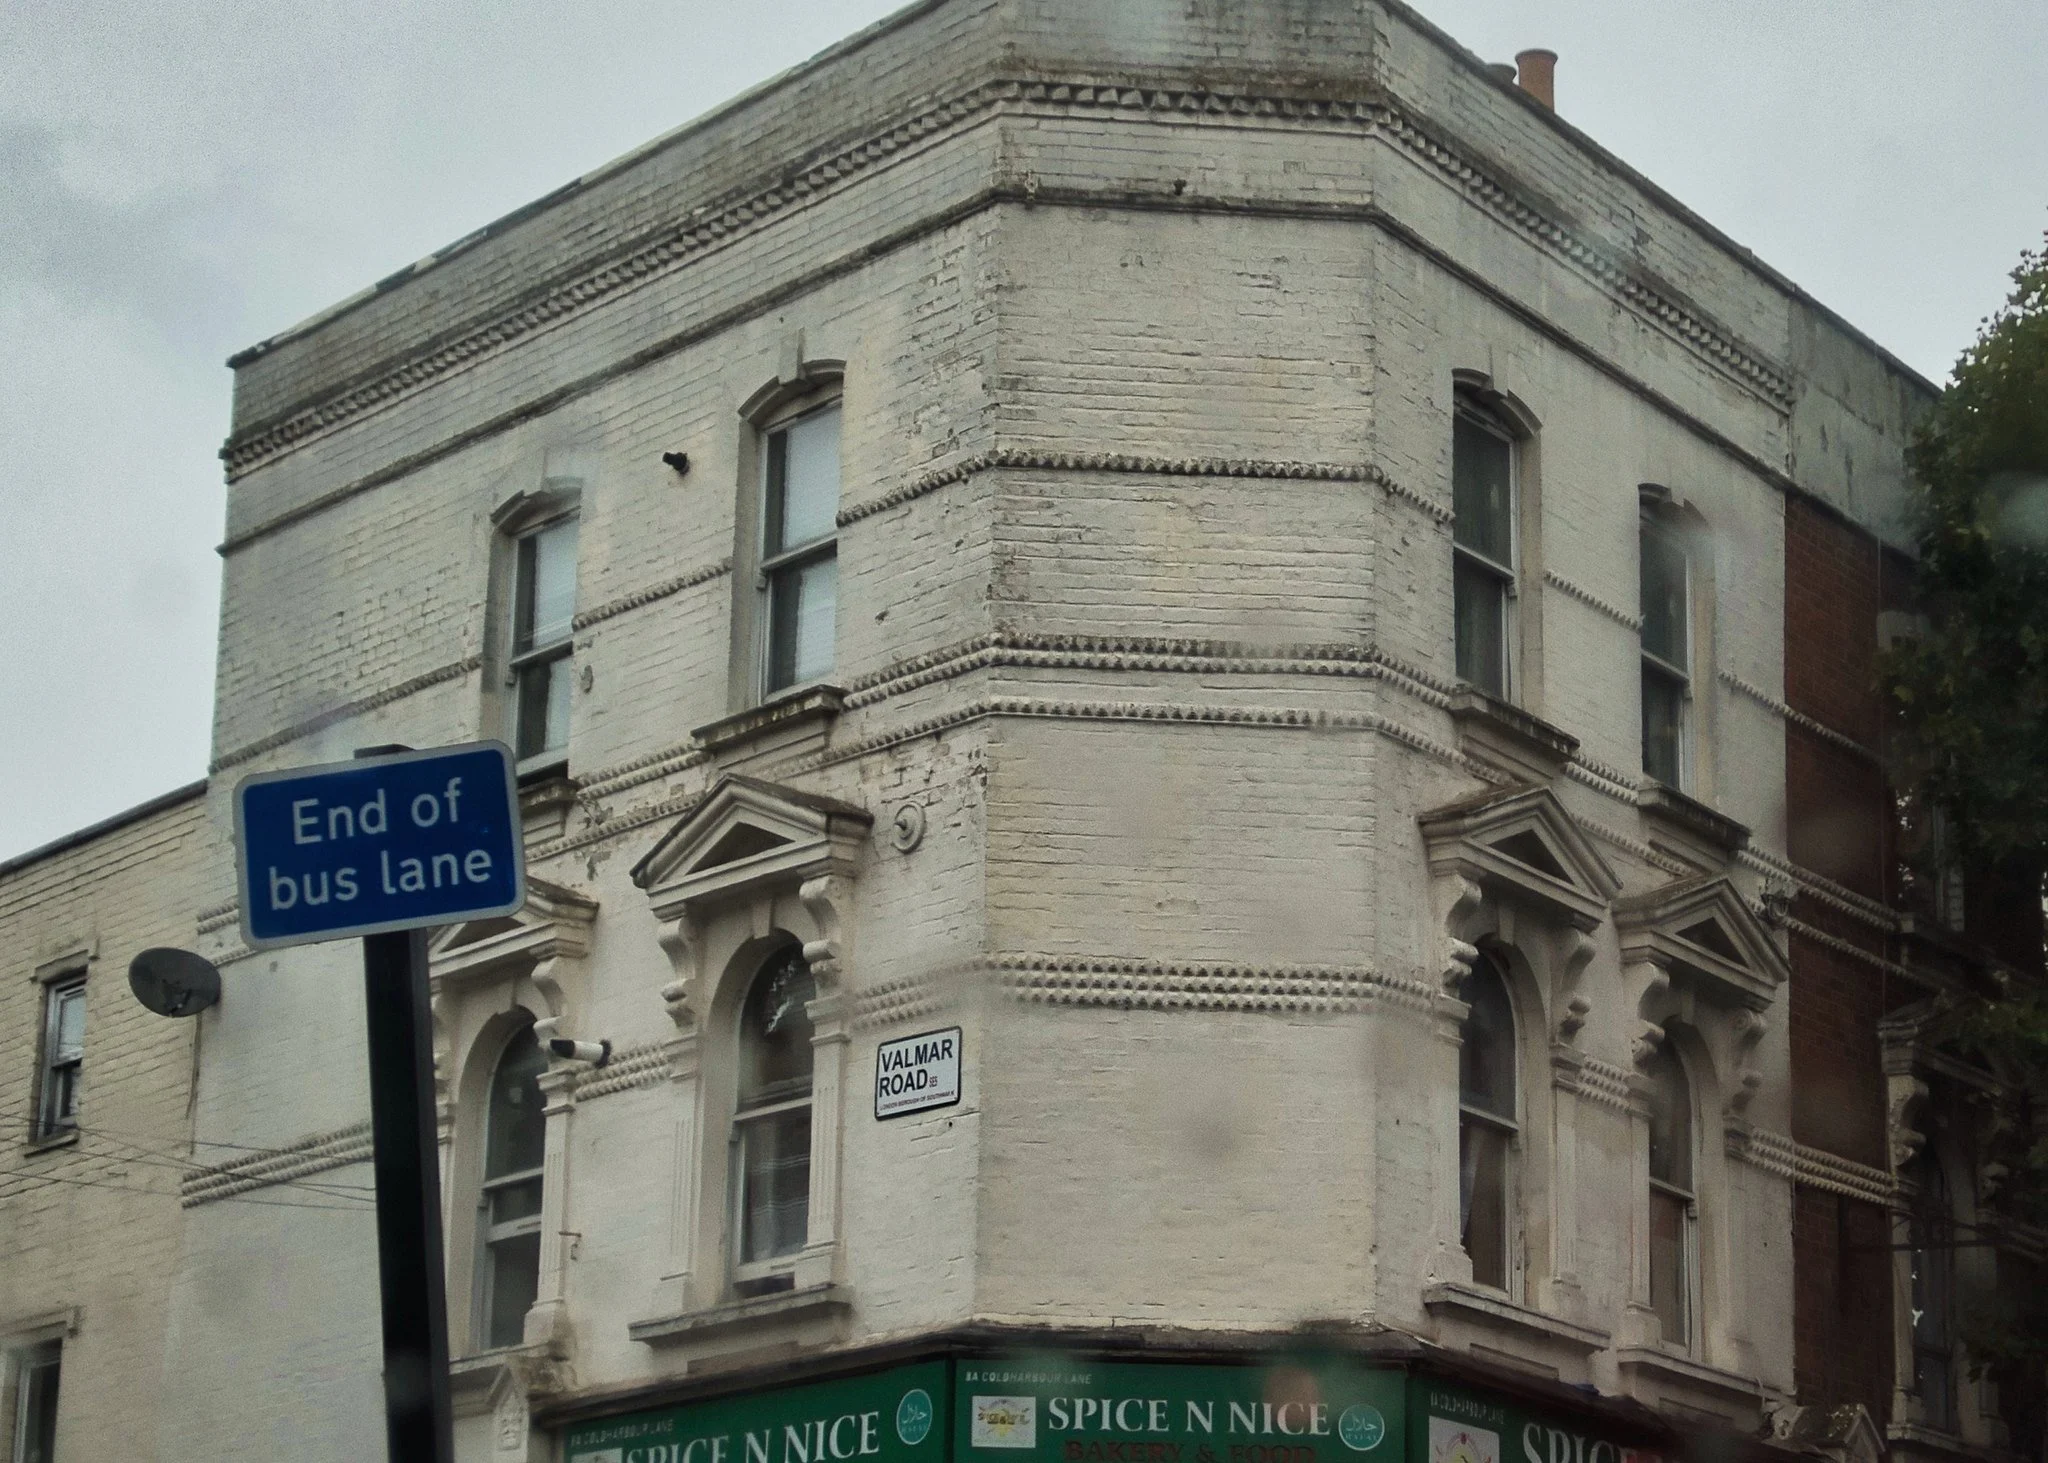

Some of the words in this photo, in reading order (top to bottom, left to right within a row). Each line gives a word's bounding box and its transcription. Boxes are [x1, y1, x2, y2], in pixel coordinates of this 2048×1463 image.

[292, 788, 388, 846] End
[410, 776, 463, 828] of
[268, 865, 360, 911] bus
[380, 848, 492, 896] lane
[881, 1038, 953, 1073] VALMAR
[879, 1068, 928, 1098] ROAD
[981, 1371, 1060, 1384] COLDHARBOUR
[1063, 1373, 1092, 1385] LANE
[1048, 1397, 1170, 1432] SPICE
[1186, 1400, 1214, 1433] N
[1227, 1401, 1331, 1436] NICE
[745, 1428, 772, 1463] N
[784, 1411, 880, 1463] NICE
[1064, 1440, 1185, 1463] BAKERY
[1195, 1443, 1216, 1463] &
[1230, 1444, 1317, 1463] FOOD
